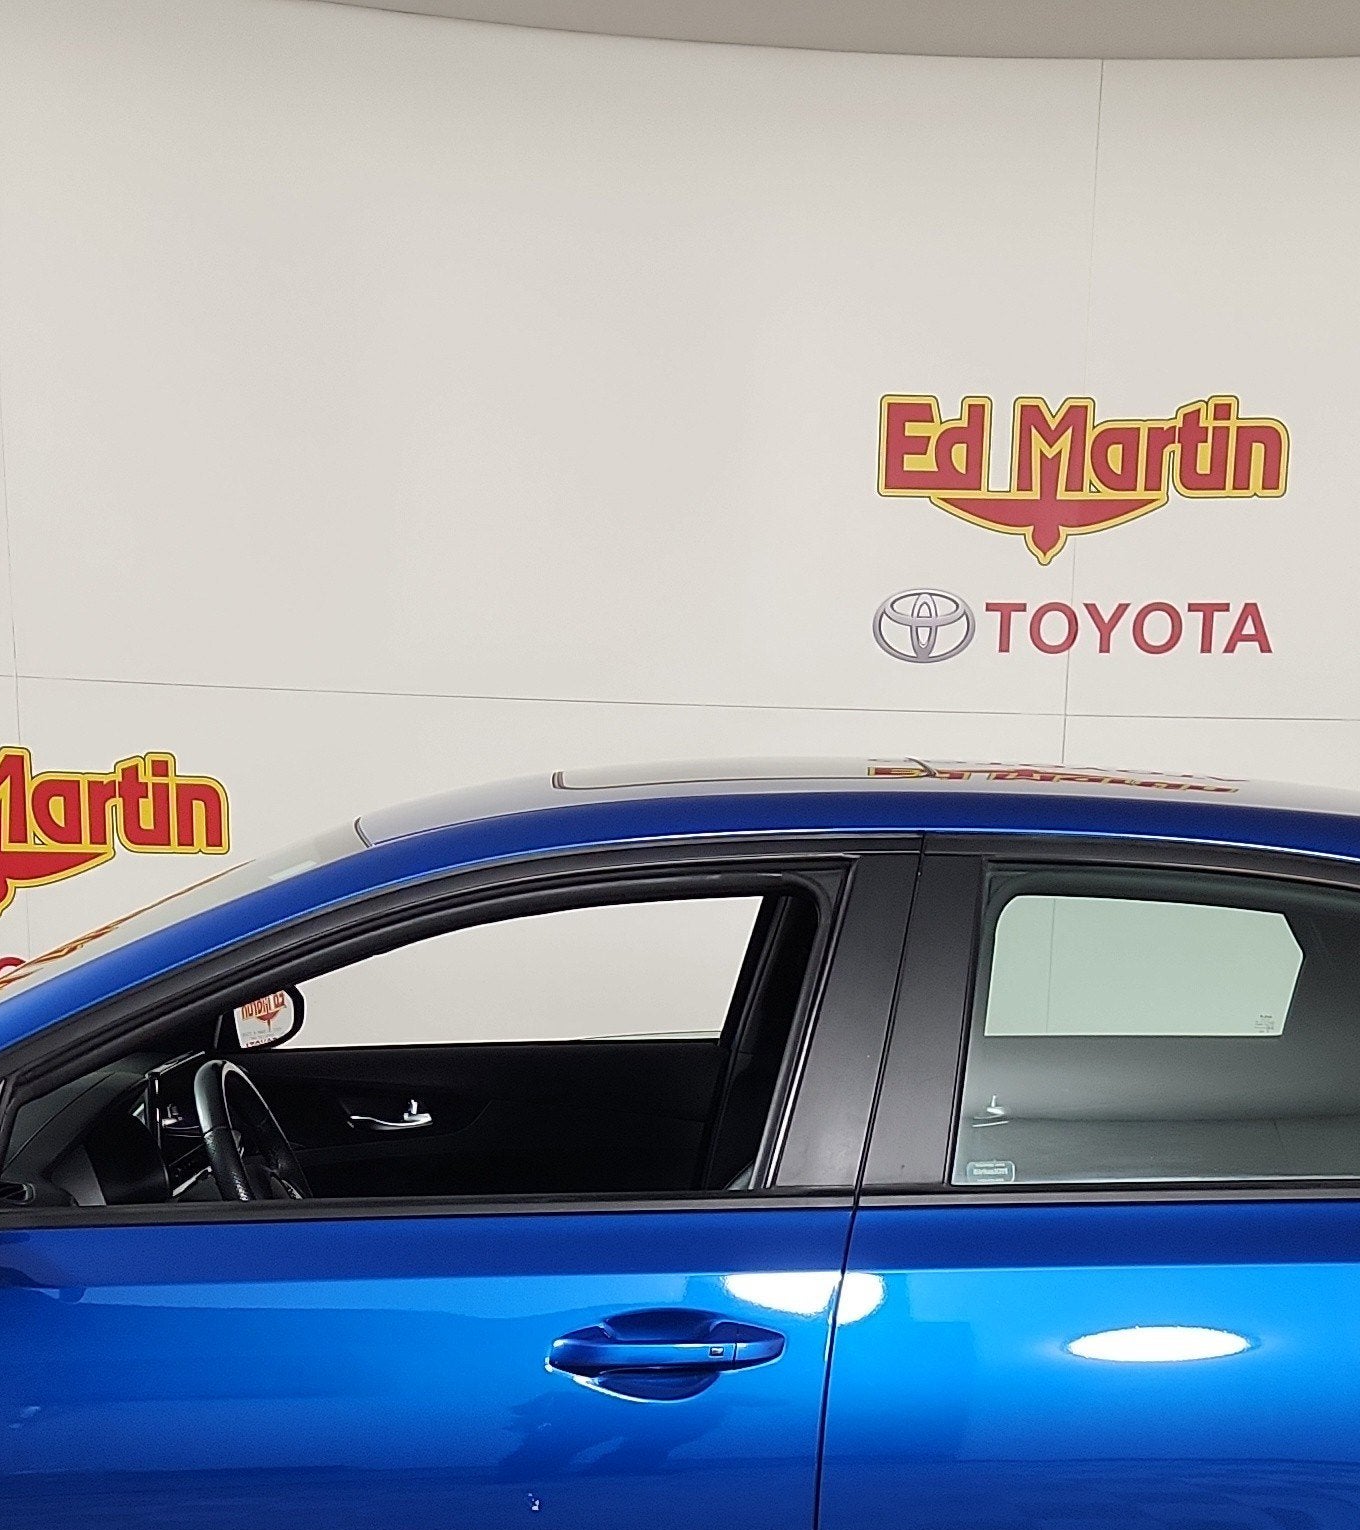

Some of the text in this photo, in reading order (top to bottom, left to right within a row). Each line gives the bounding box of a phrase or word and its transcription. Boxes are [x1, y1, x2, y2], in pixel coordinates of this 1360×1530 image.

[881, 397, 1287, 495] Ed Martin
[984, 601, 1274, 655] TOYOTA
